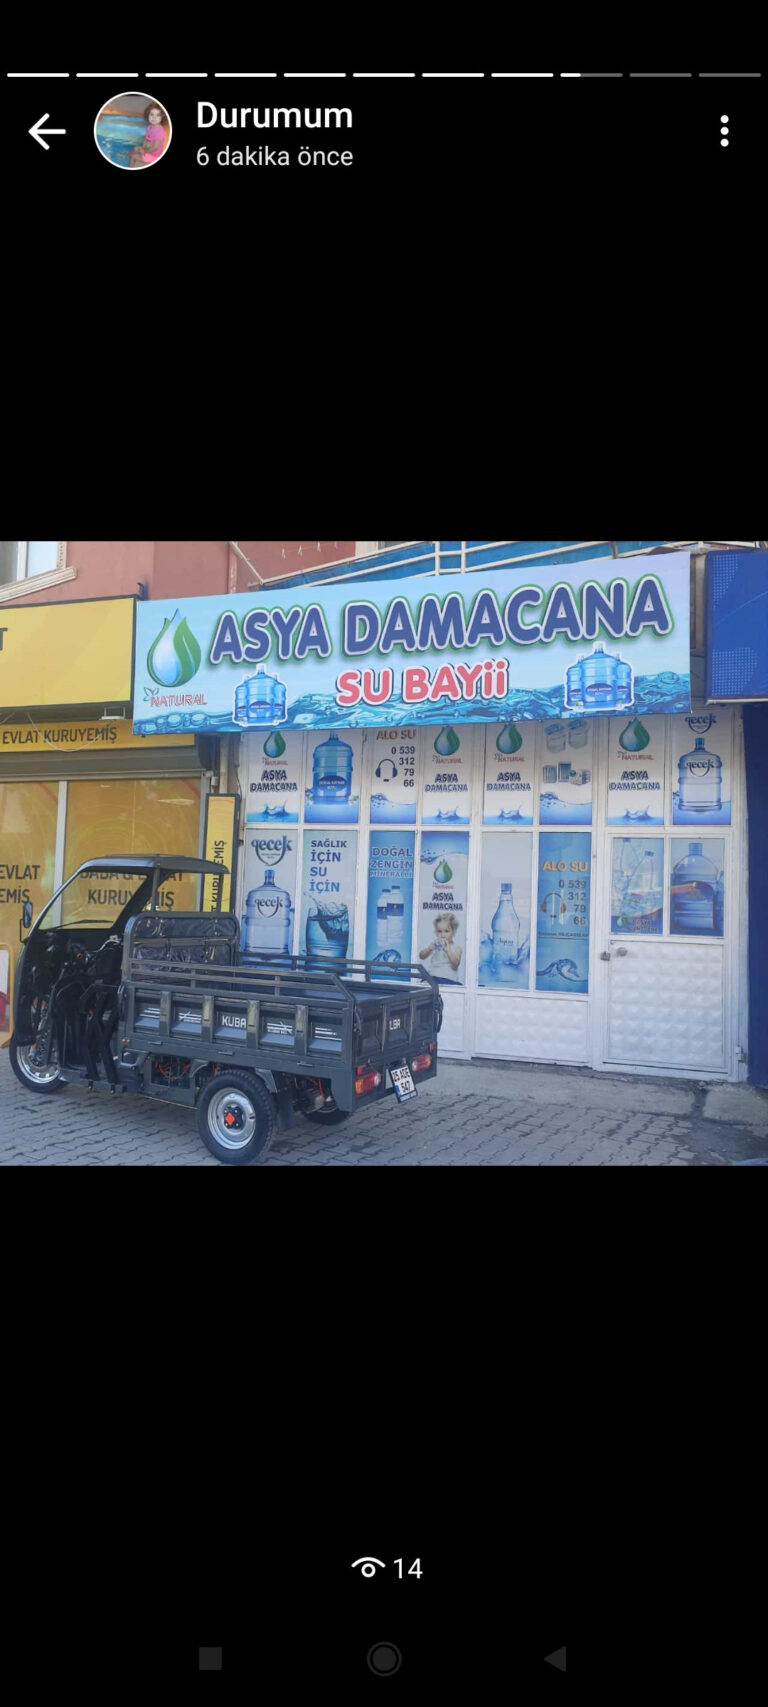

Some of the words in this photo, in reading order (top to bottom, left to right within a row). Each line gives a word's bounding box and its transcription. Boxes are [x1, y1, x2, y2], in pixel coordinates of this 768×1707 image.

[209, 604, 331, 664] ASYA
[344, 576, 673, 656] DAMACANA
[336, 669, 393, 707] SU
[151, 694, 208, 707] NATURAL
[2, 730, 41, 745] EVLAT
[44, 725, 118, 744] KURUYEMİŞ
[376, 730, 398, 740] ALO
[401, 729, 417, 740] SU
[391, 746, 397, 755] 0
[399, 746, 416, 755] 539
[399, 757, 415, 766] 312
[261, 769, 288, 781] ASYA
[404, 768, 415, 777] 79
[497, 772, 521, 782] ASYA
[621, 770, 649, 781] ASYA
[435, 773, 459, 783] ASYA
[250, 782, 298, 792] DAMACANA
[403, 779, 415, 788] 66
[424, 783, 468, 792] DAMACANA
[486, 782, 531, 792] DAMACANA
[608, 782, 660, 791] DAMACANA
[310, 838, 348, 848] SAĞLIK
[310, 849, 342, 864] İÇİN
[372, 846, 413, 857] DOĞAL
[371, 858, 413, 869] ZENGİN
[542, 861, 567, 873] ALO
[570, 861, 589, 873] SU
[0, 864, 41, 880] EVLAT
[309, 866, 328, 877] SU
[309, 879, 340, 894] İÇİN
[559, 880, 565, 889] 0
[568, 880, 587, 889] 539
[432, 892, 454, 902] ASYA
[568, 892, 587, 901] 312
[422, 902, 463, 911] DAMACANA
[574, 904, 587, 913] 79
[573, 916, 587, 925] 66
[222, 1015, 247, 1029] KUBA
